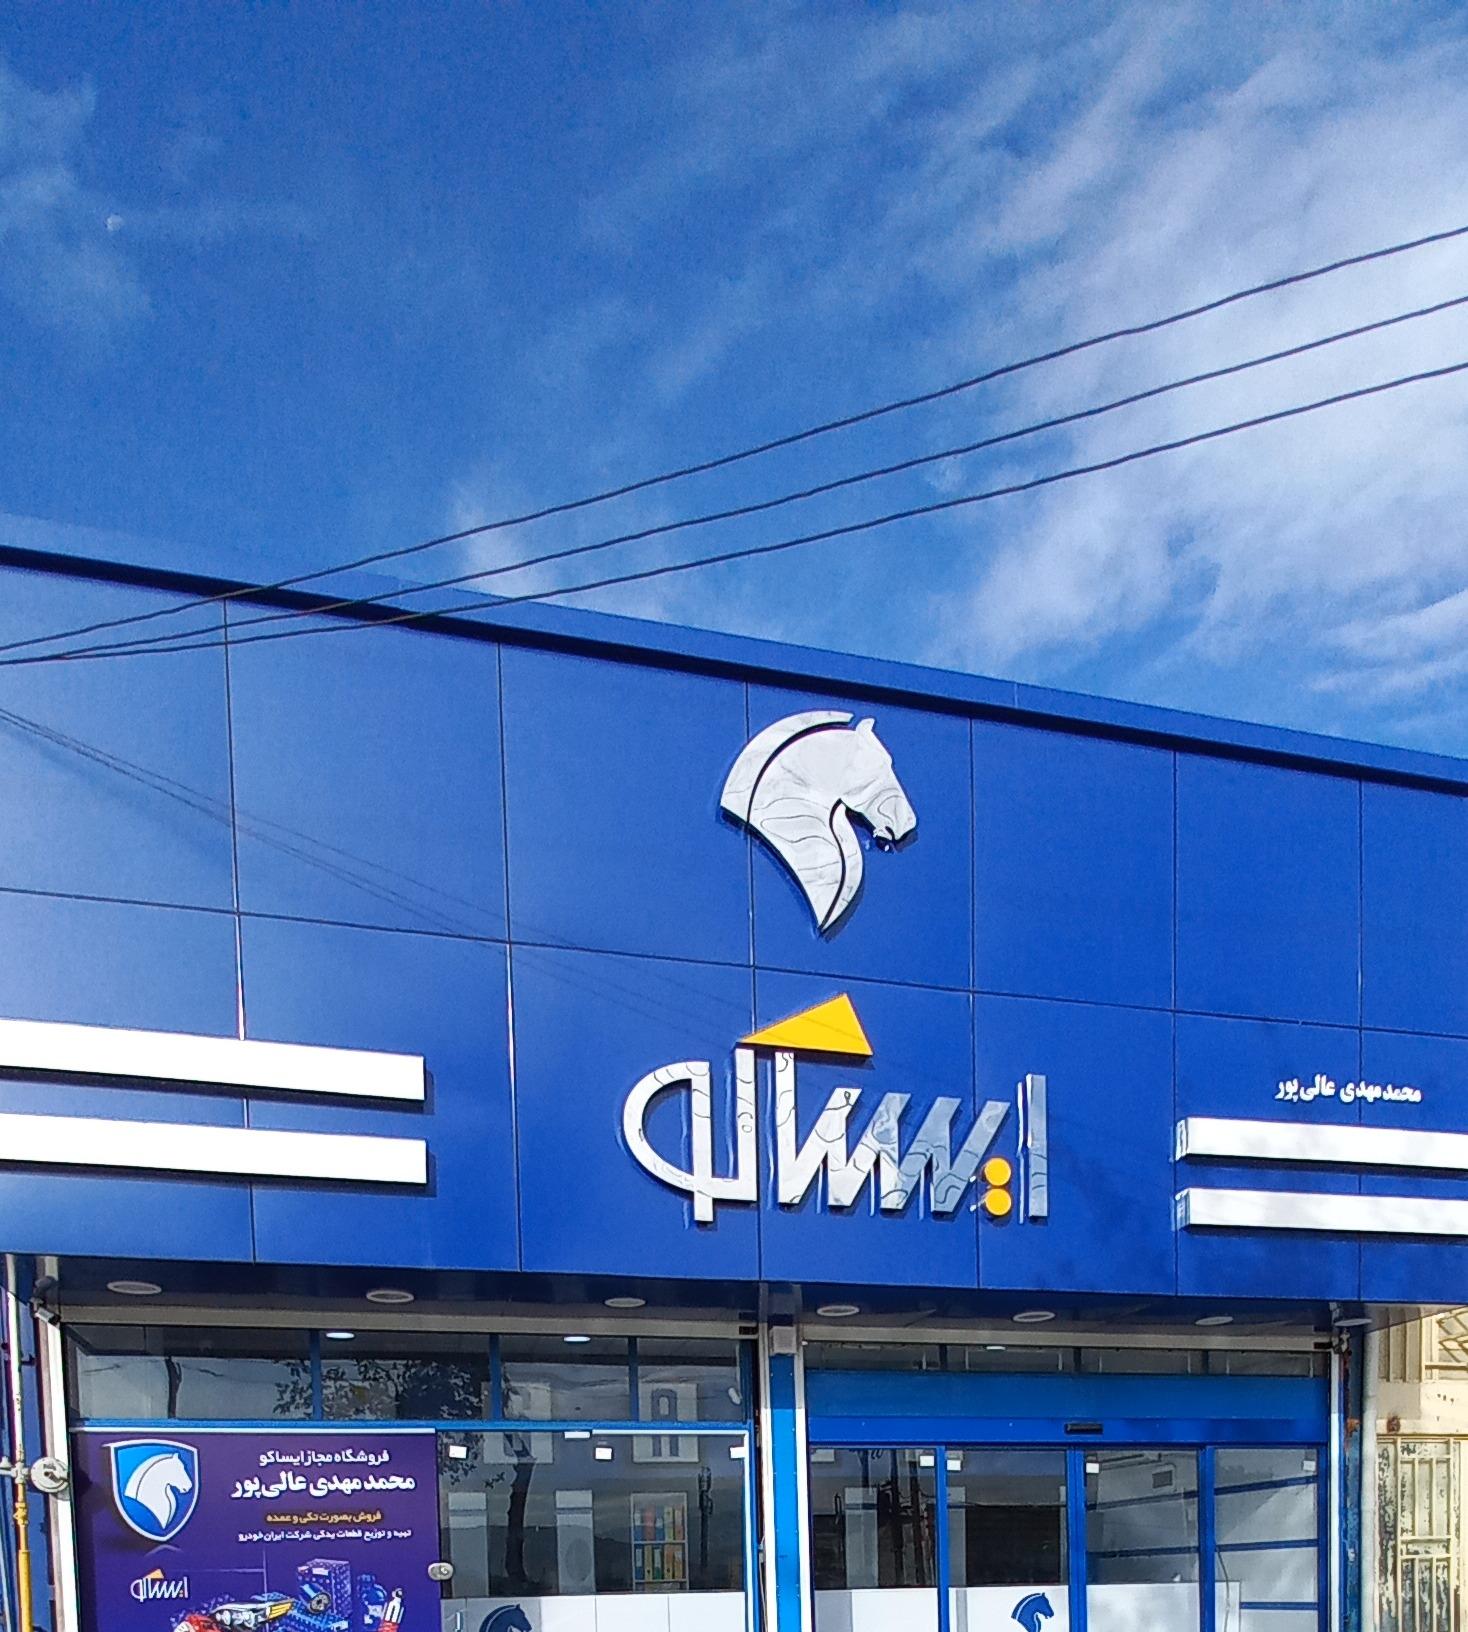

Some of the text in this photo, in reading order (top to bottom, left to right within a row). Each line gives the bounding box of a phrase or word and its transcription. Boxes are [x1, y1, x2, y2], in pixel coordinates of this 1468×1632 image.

[259, 1448, 390, 1467] فروشگاه مجاز ایساکو
[309, 1474, 362, 1497] مهدی
[363, 1472, 416, 1491] محمد
[266, 1513, 292, 1523] عمده
[319, 1511, 352, 1524] بصورت
[353, 1510, 382, 1523] فروش
[238, 1531, 264, 1542] خودرو
[263, 1530, 285, 1542] ایران
[285, 1530, 312, 1542] شرکت
[312, 1529, 335, 1541] یدکی
[336, 1529, 362, 1538] قطعات
[363, 1528, 386, 1542] توزیع
